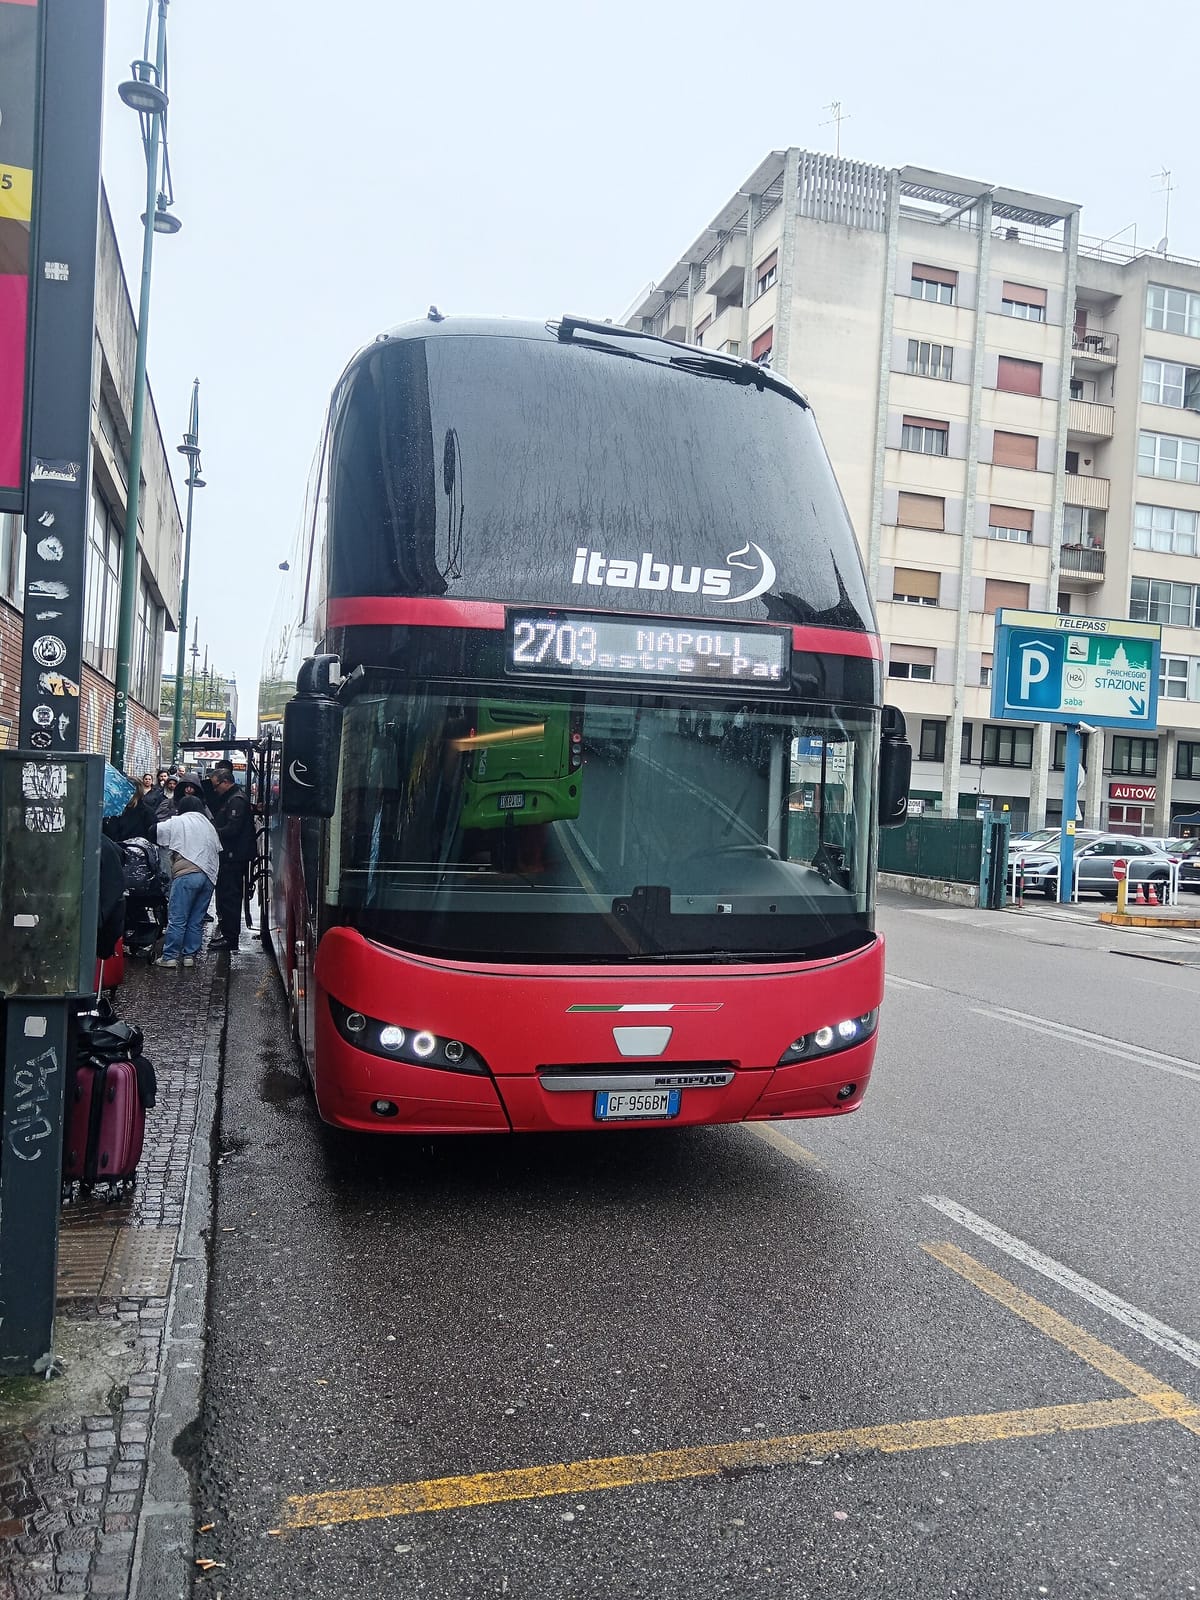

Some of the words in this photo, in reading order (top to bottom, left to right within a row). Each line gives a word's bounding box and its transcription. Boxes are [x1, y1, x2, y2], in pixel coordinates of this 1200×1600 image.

[572, 547, 732, 596] itabus
[1058, 618, 1107, 632] TELEPASS
[513, 621, 597, 667] 2703
[637, 630, 741, 658] NAPOLI
[1020, 649, 1050, 700] P
[1069, 674, 1083, 683] H24
[1106, 668, 1147, 679] PARCHEGGIO
[1095, 677, 1146, 692] STAZIONE
[1064, 696, 1083, 707] saba
[655, 1074, 727, 1085] NEOPLAN
